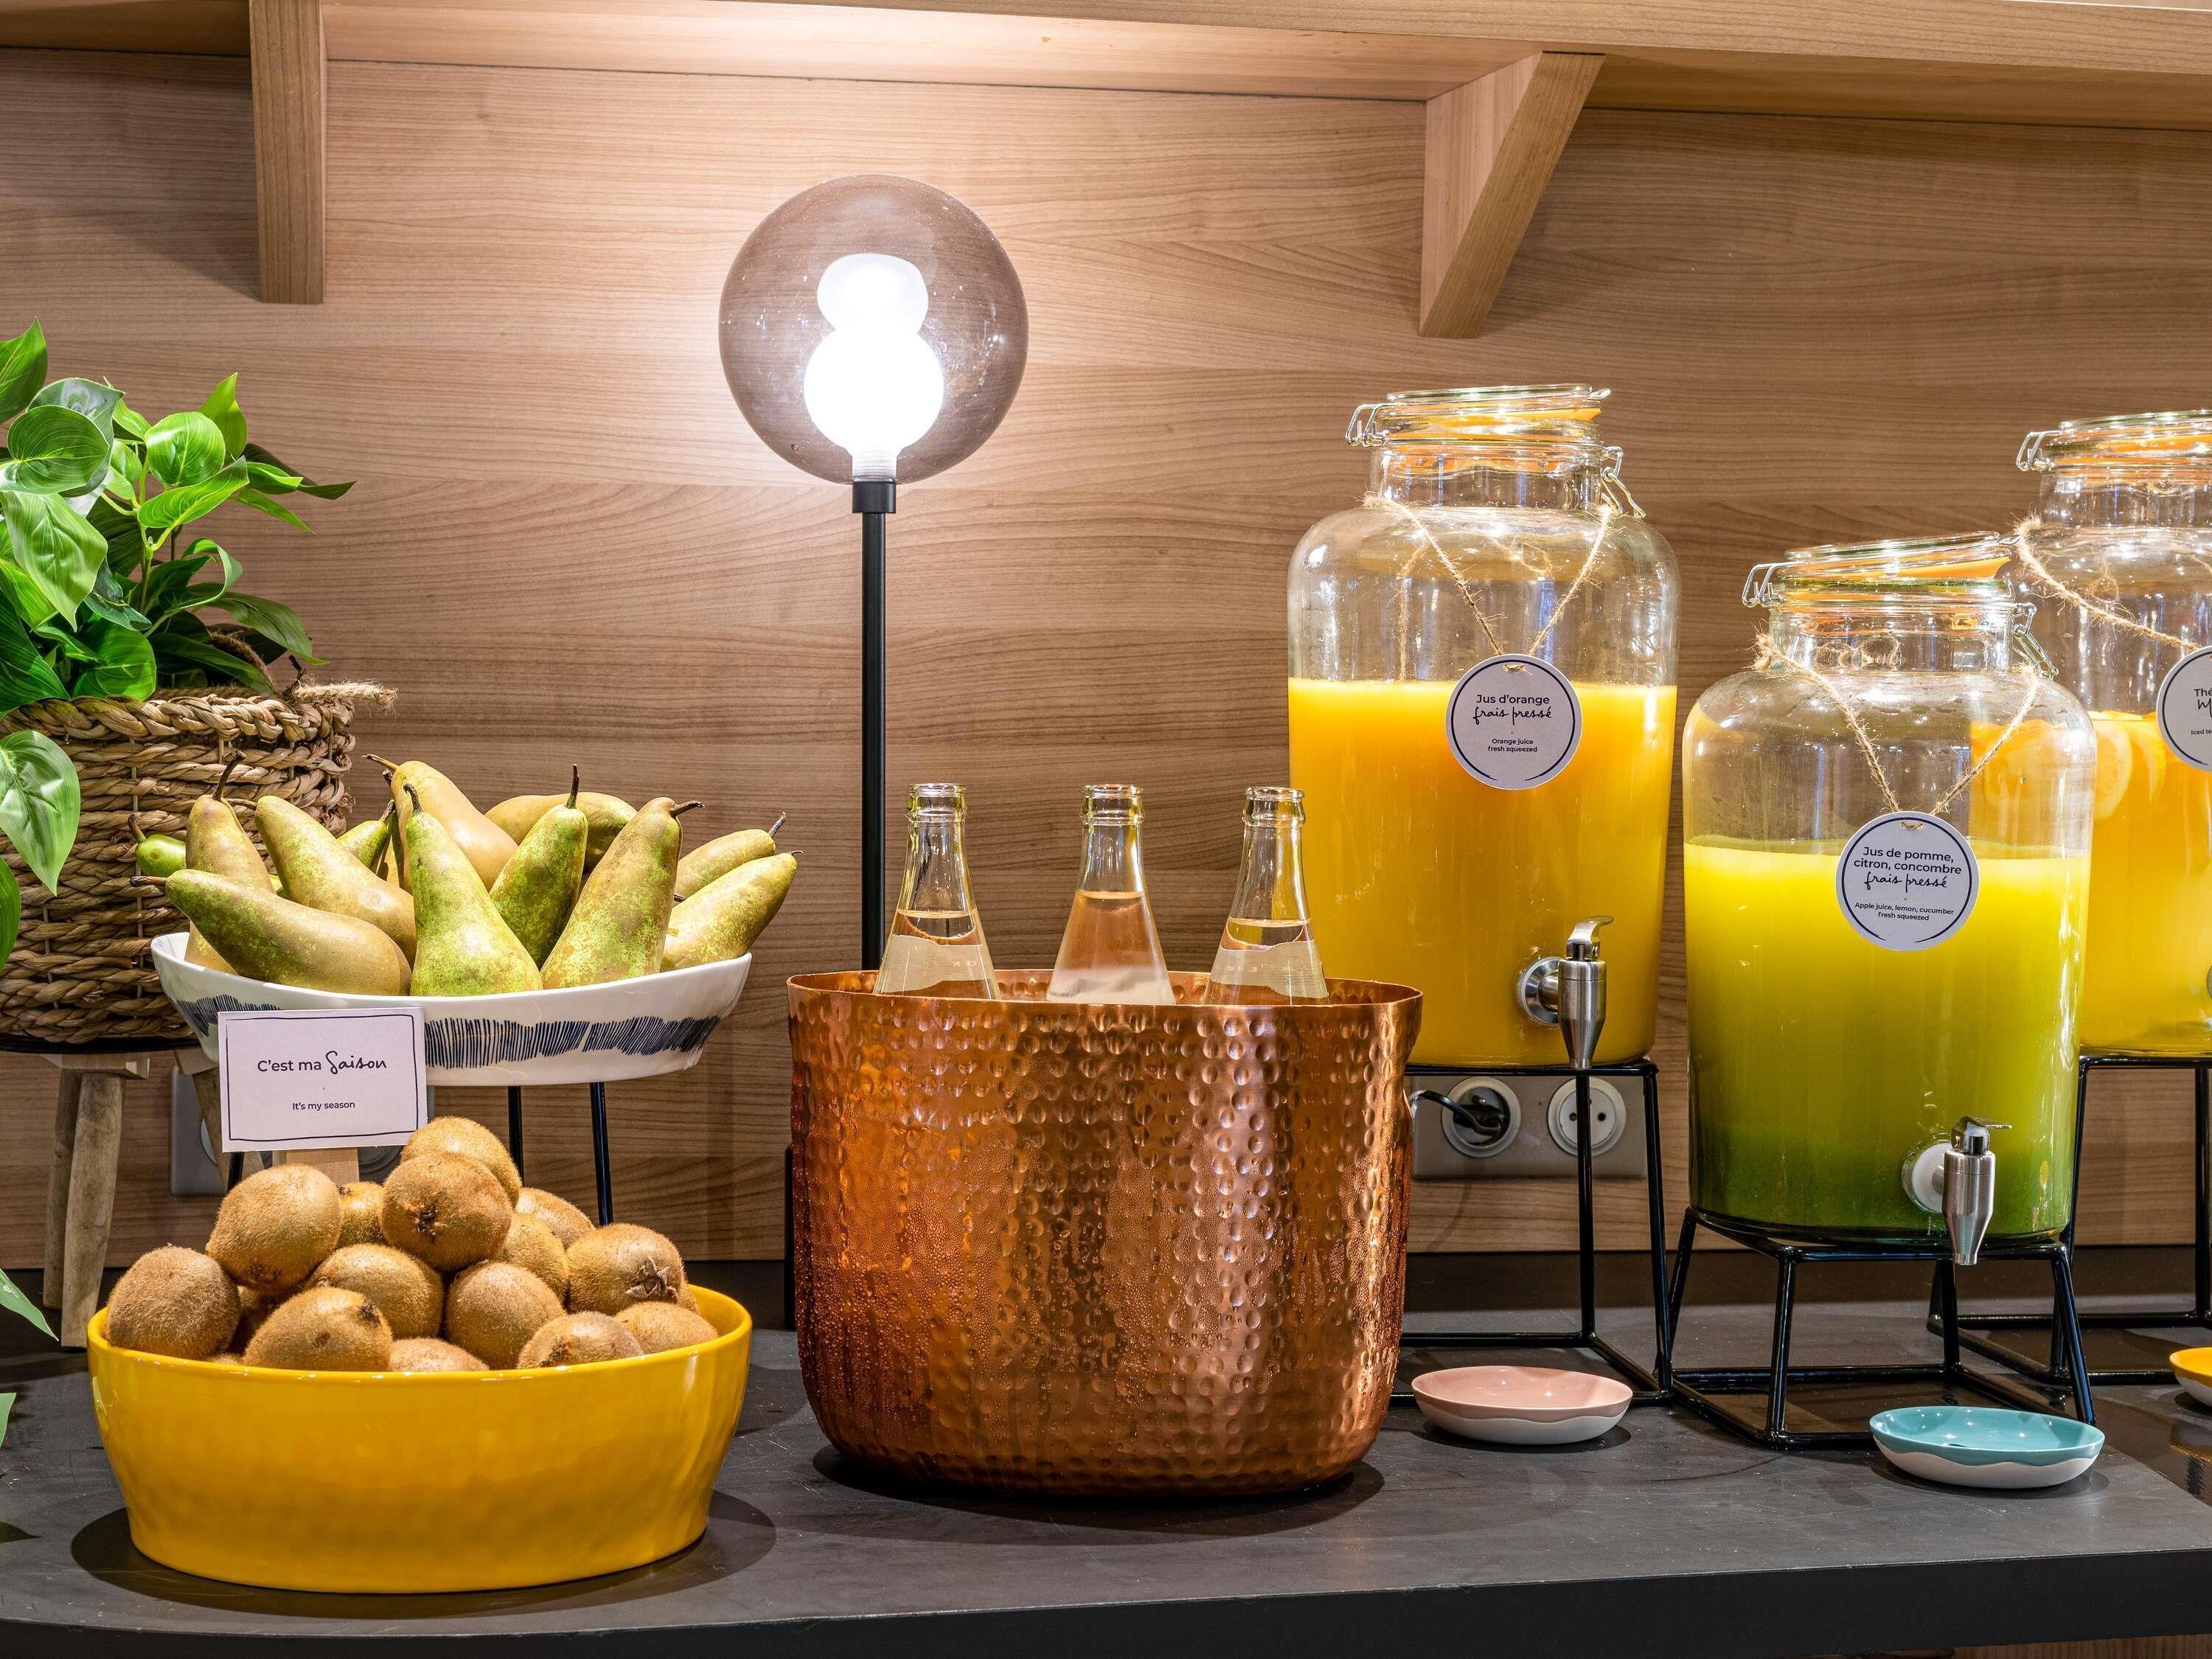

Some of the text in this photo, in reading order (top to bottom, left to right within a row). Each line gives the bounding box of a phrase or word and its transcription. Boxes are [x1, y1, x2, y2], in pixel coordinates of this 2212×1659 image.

[1476, 695, 1495, 703] Jus
[1473, 706, 1551, 725] frais pressé
[1863, 846, 1954, 863] Jus de pomme,
[1854, 858, 1961, 874] citron, concombre
[1864, 872, 1947, 893] frais pressé
[299, 1060, 321, 1071] ma
[325, 1050, 386, 1074] Saison
[307, 1103, 322, 1111] my
[324, 1101, 355, 1109] season
